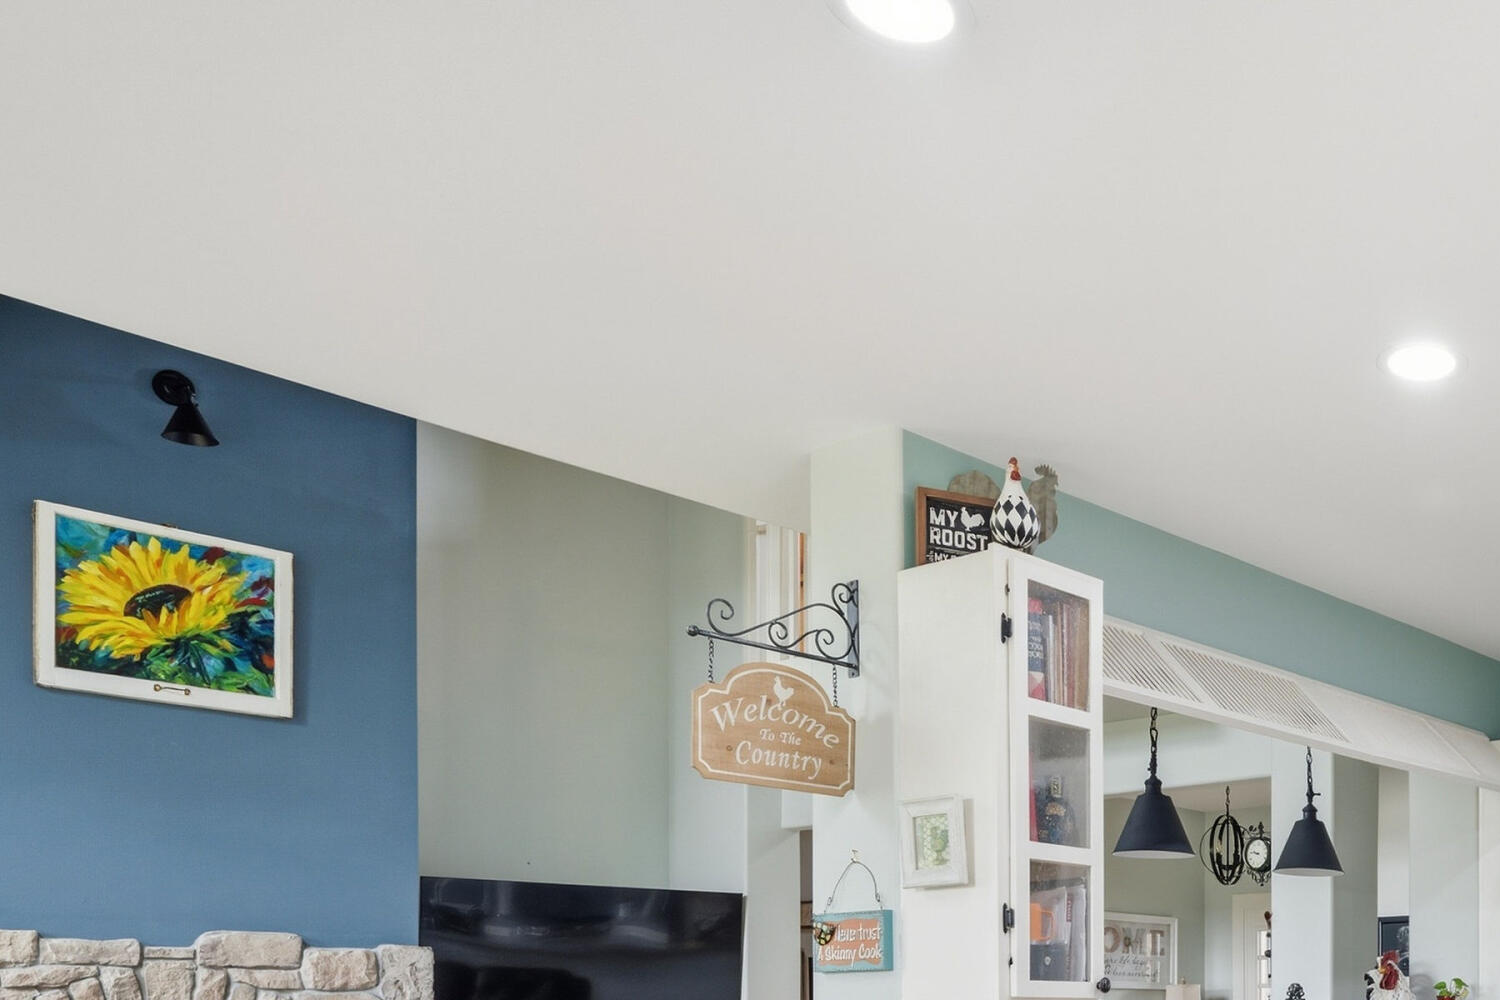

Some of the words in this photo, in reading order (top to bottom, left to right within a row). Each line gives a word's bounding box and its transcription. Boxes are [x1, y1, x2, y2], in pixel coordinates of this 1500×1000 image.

[929, 506, 959, 528] MY
[929, 526, 989, 551] ROOST
[710, 694, 840, 749] Welcome
[760, 728, 776, 741] To
[780, 731, 802, 746] The
[735, 740, 823, 780] Country
[857, 921, 884, 941] trust
[825, 945, 857, 969] Skinny
[858, 943, 884, 960] Cook
